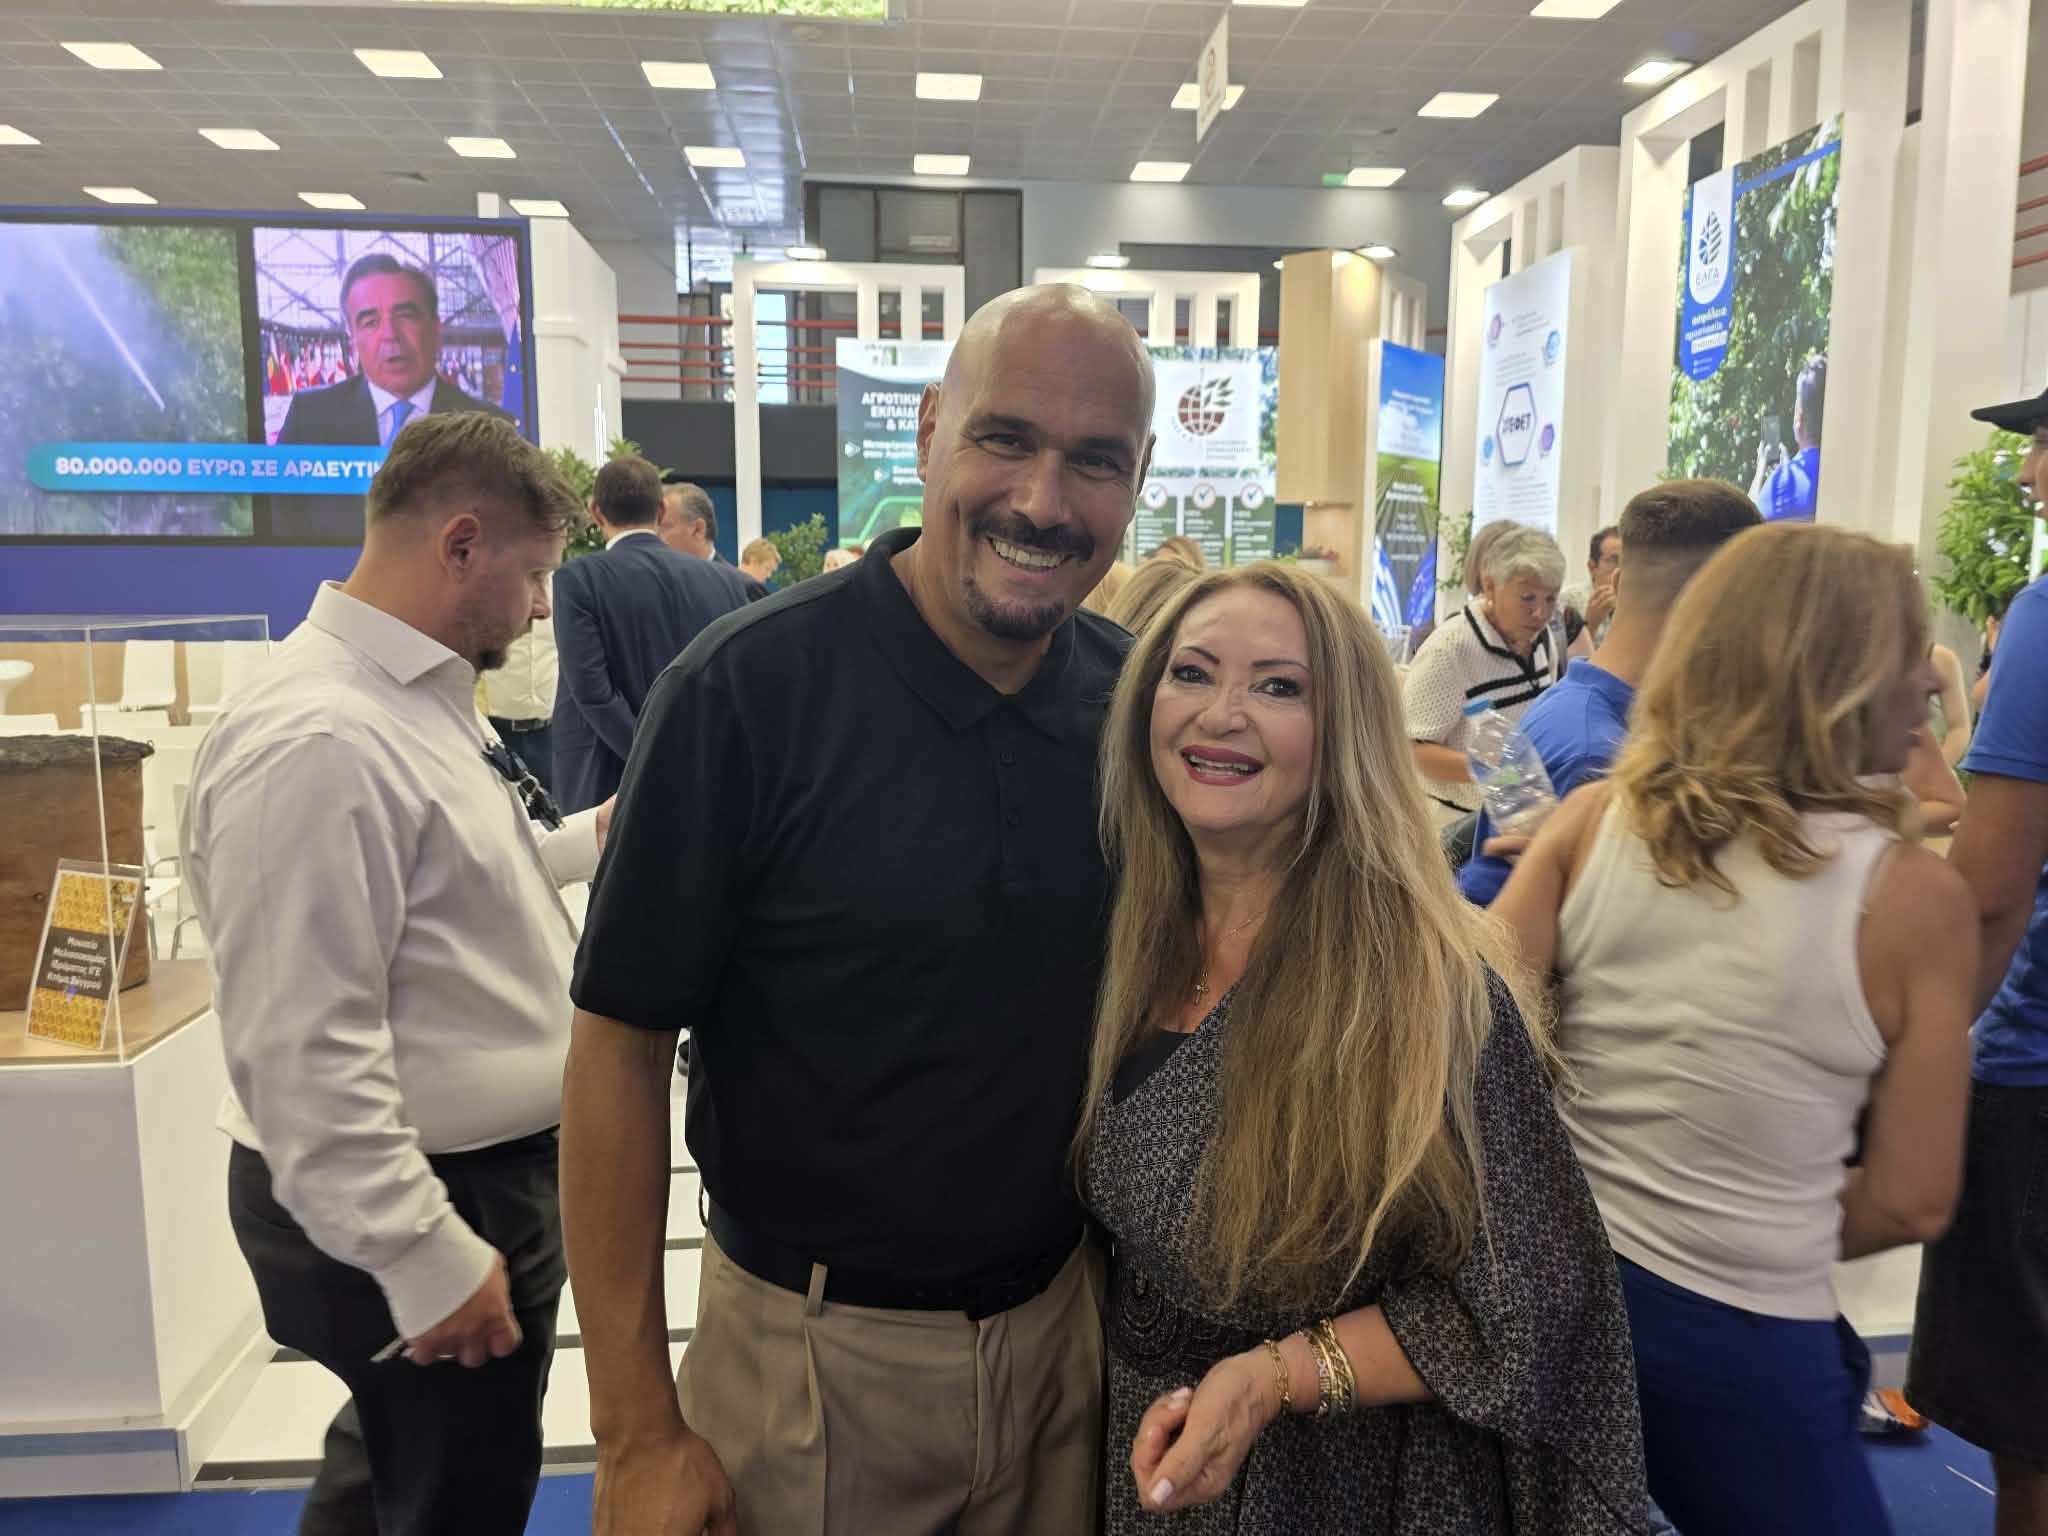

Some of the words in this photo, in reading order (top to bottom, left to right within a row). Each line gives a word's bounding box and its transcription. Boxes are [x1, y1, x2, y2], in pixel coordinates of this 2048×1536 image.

[55, 457, 182, 476] 80.000.000
[187, 459, 246, 477] ΕΥΡΩ
[251, 459, 279, 477] ΣΕ
